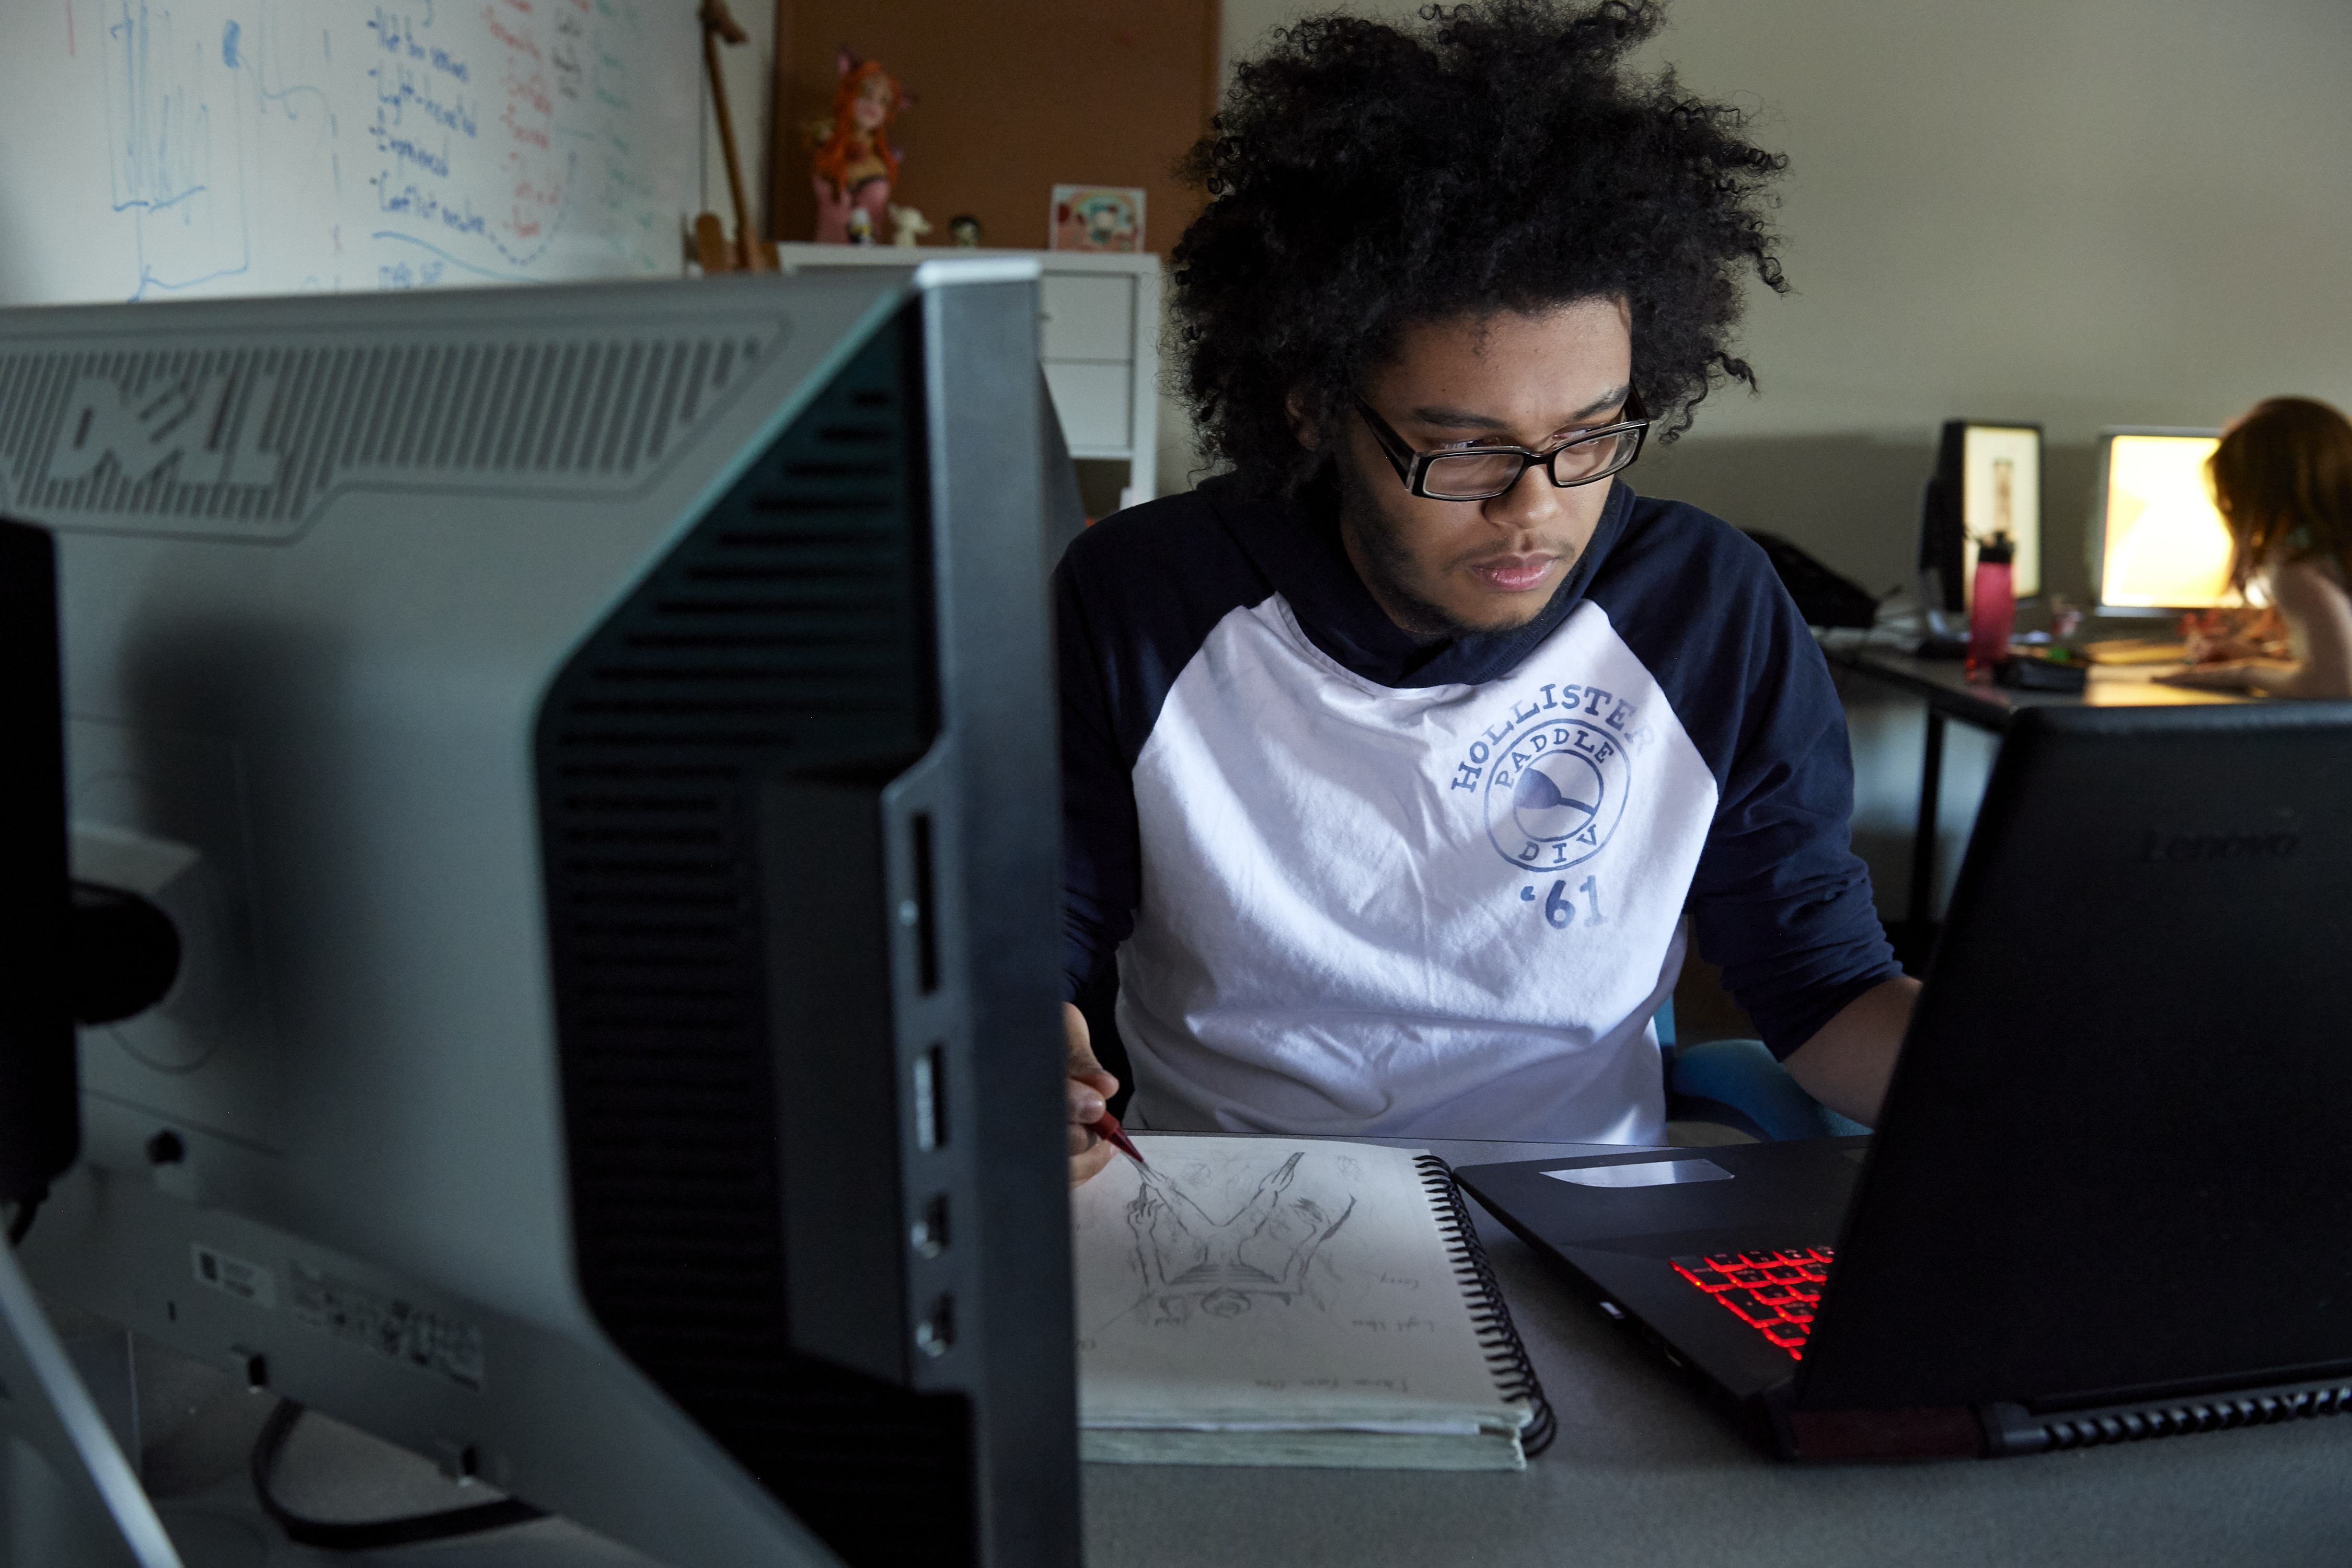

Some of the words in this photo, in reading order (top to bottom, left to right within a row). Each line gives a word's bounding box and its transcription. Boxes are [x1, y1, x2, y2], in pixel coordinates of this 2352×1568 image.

[50, 375, 282, 485] DELL
[1451, 683, 1655, 794] HOLLISTER
[1495, 728, 1615, 790] PADDLE
[1518, 824, 1598, 864] DIV
